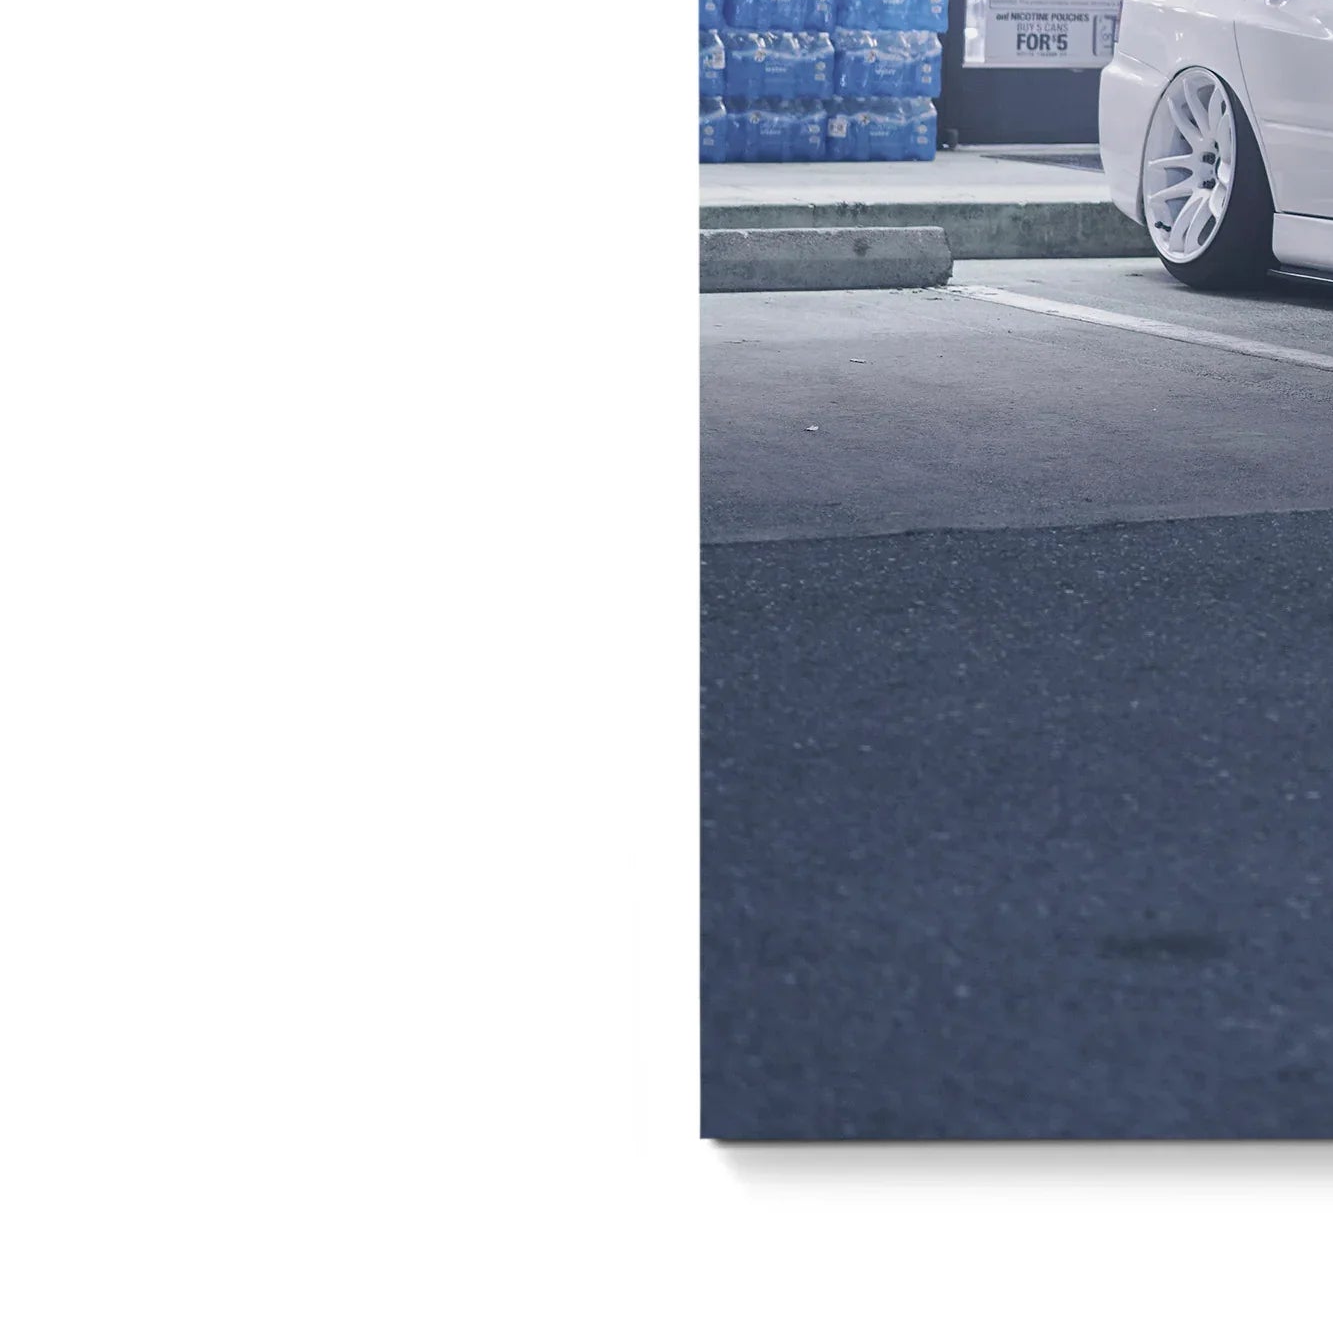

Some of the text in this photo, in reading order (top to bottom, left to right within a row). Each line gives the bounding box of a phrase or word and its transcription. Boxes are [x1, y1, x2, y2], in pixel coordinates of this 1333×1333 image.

[1010, 12, 1049, 22] NICOTINE
[1051, 12, 1090, 22] POUCHES
[1044, 23, 1069, 33] CANS
[1016, 33, 1051, 51] FOR
